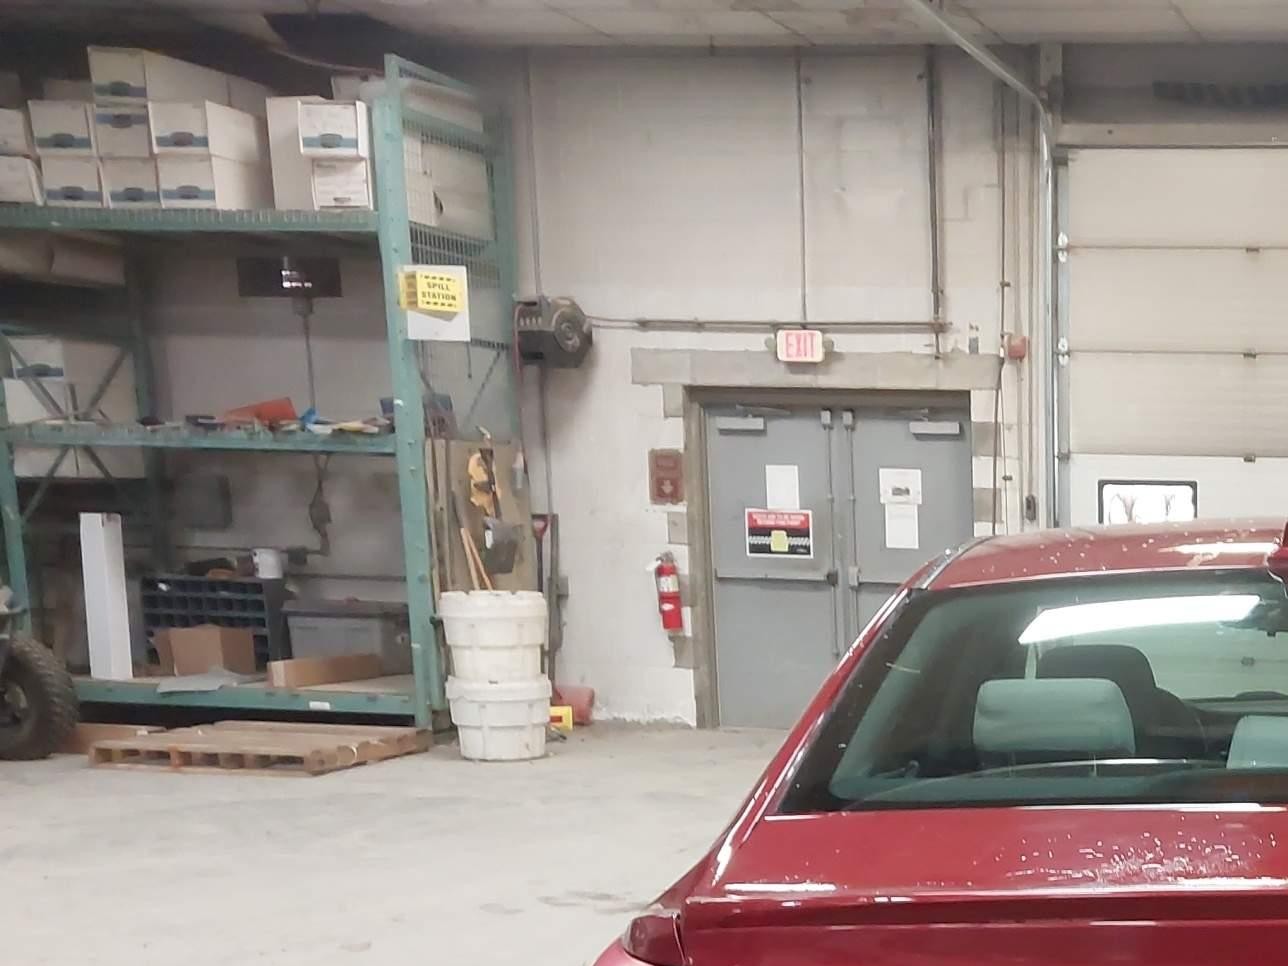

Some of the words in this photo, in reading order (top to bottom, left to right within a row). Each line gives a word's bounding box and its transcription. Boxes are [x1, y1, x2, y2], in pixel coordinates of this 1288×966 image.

[426, 282, 451, 291] SPILL
[421, 291, 457, 301] STATION
[785, 332, 816, 358] EXIT
